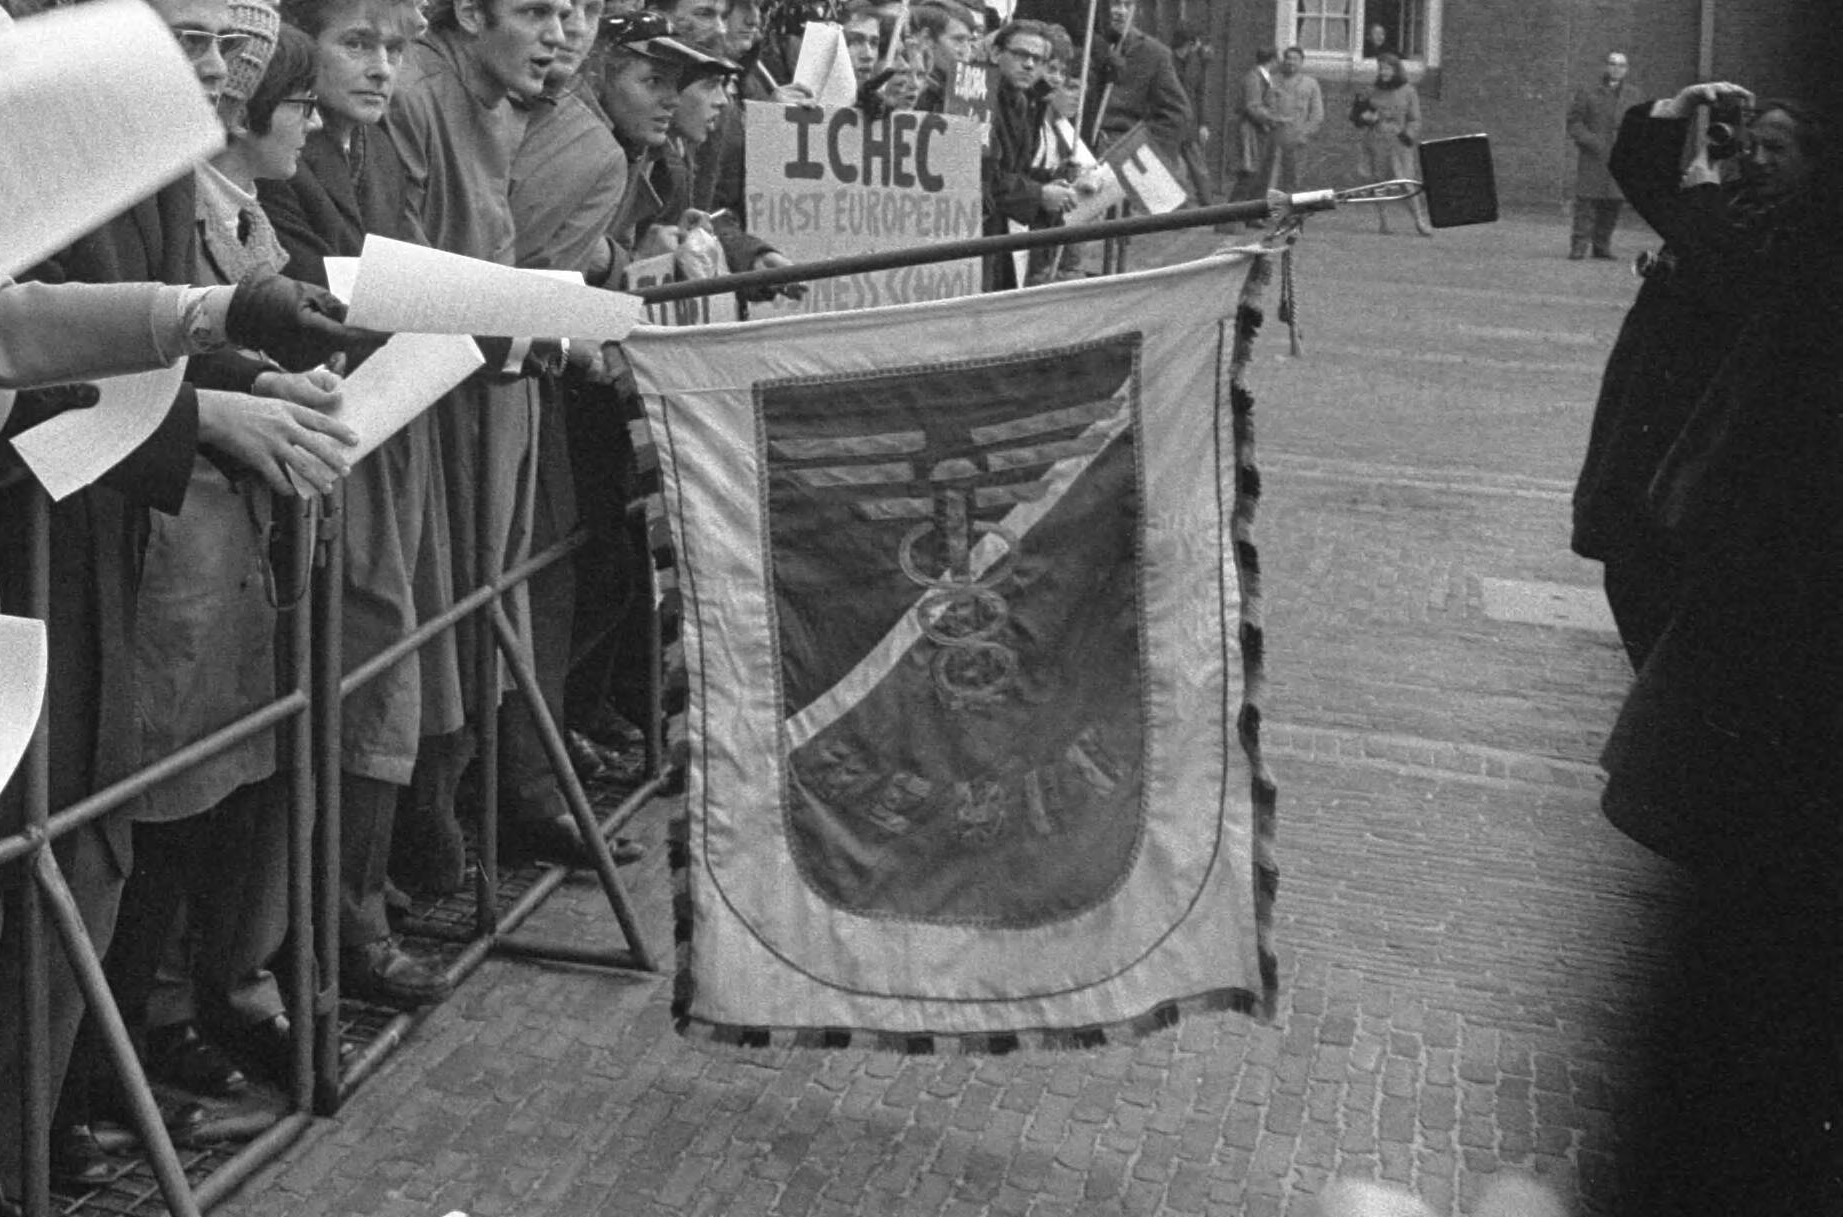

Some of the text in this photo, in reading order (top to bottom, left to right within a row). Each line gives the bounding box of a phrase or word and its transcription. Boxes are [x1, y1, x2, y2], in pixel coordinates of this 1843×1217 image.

[784, 105, 948, 193] ICHEC
[748, 188, 981, 237] FIRST EUROPEAN
